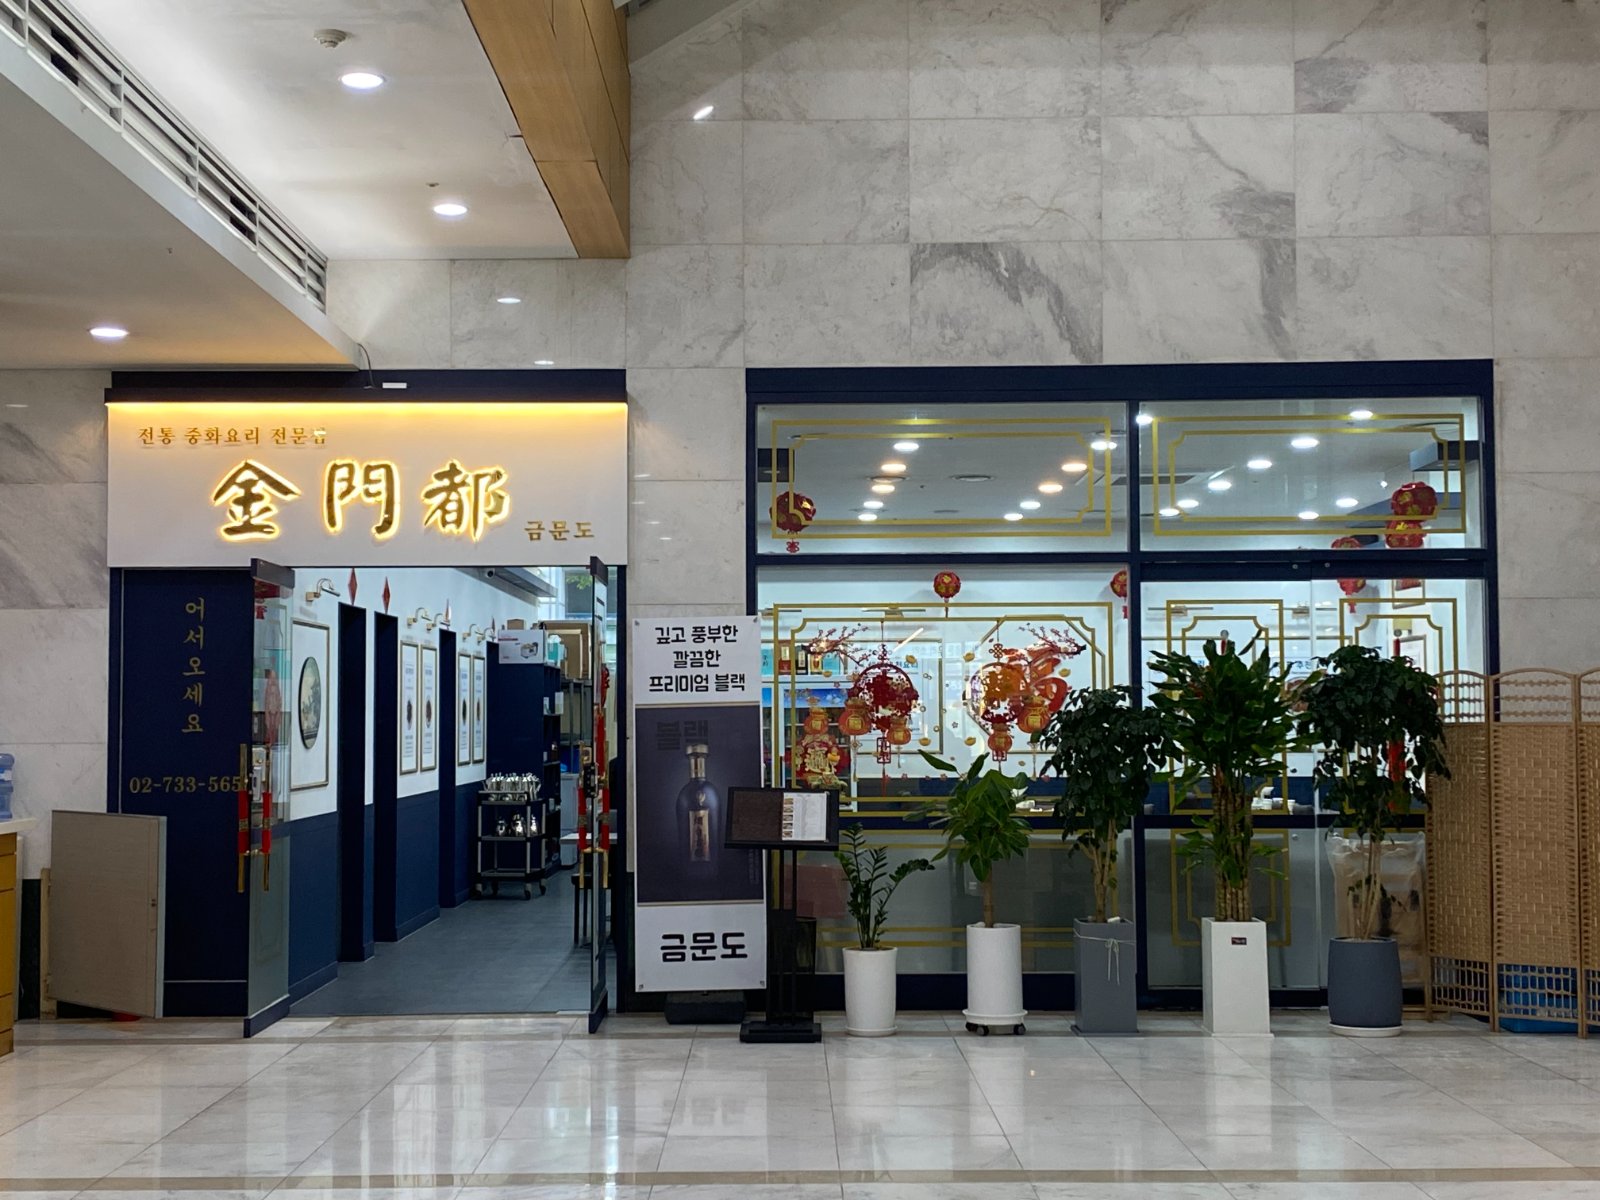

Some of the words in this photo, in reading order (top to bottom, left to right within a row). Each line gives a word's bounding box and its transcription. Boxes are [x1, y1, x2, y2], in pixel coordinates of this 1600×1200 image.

[138, 426, 176, 446] 전통
[184, 426, 261, 446] 중화요리
[211, 457, 512, 543] 金門都
[524, 520, 595, 541] 금문도
[655, 626, 687, 645] 깊고
[691, 624, 739, 644] 풍부한
[181, 596, 206, 733] 어서오세요
[673, 649, 721, 669] 깔끔한
[648, 674, 710, 693] 프리미엄
[714, 673, 746, 692] 블랙
[128, 775, 248, 794] 02-733-565
[660, 932, 749, 963] 금문도
